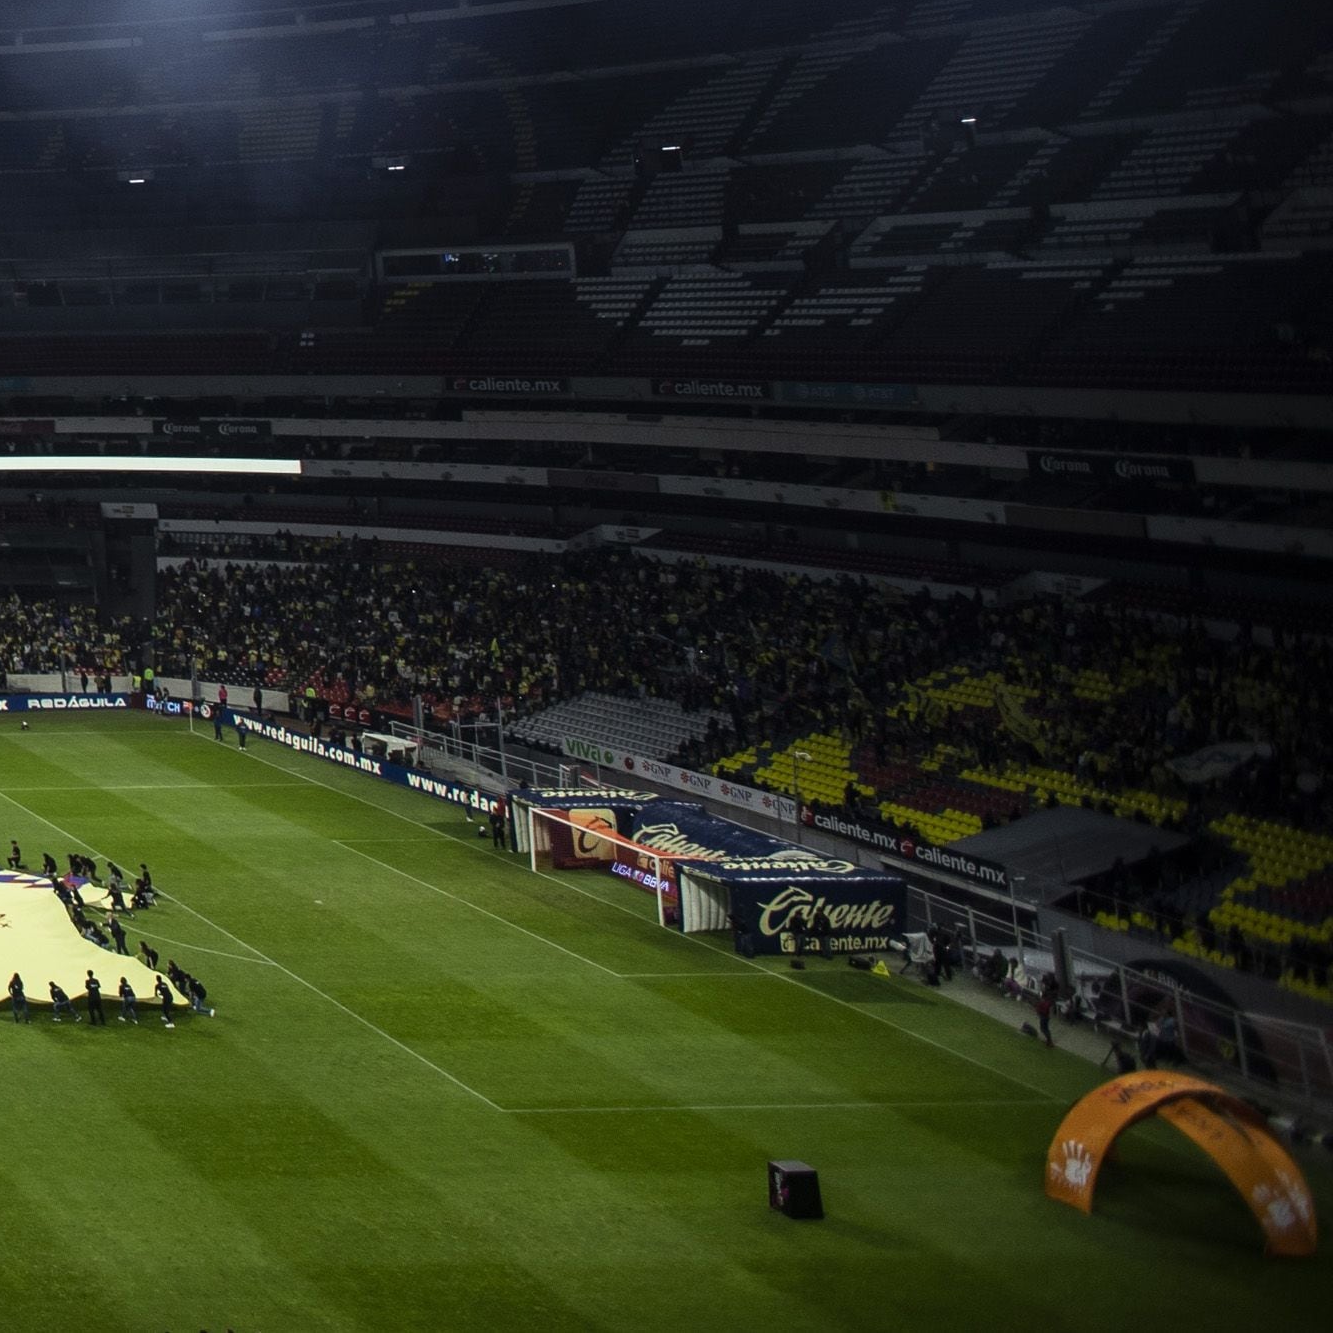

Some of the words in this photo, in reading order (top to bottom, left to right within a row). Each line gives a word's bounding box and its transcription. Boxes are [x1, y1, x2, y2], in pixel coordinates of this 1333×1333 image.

[469, 377, 560, 392] caliente.mx
[675, 380, 763, 398] caliente.mx
[163, 422, 200, 435] Corona
[218, 422, 257, 435] Corona
[1040, 455, 1091, 473] Corona
[1115, 459, 1171, 479] Corona
[233, 714, 382, 776] www.redaguila.com.mx
[650, 764, 671, 778] GNP
[689, 773, 711, 788] GNP
[729, 786, 752, 802] GNP
[773, 798, 796, 813] GNP
[815, 813, 897, 851] caliente.mx
[612, 862, 632, 878] LIGA
[916, 842, 1006, 886] caliente.mx
[757, 886, 896, 936] Calente
[802, 934, 890, 952] caente.mx
